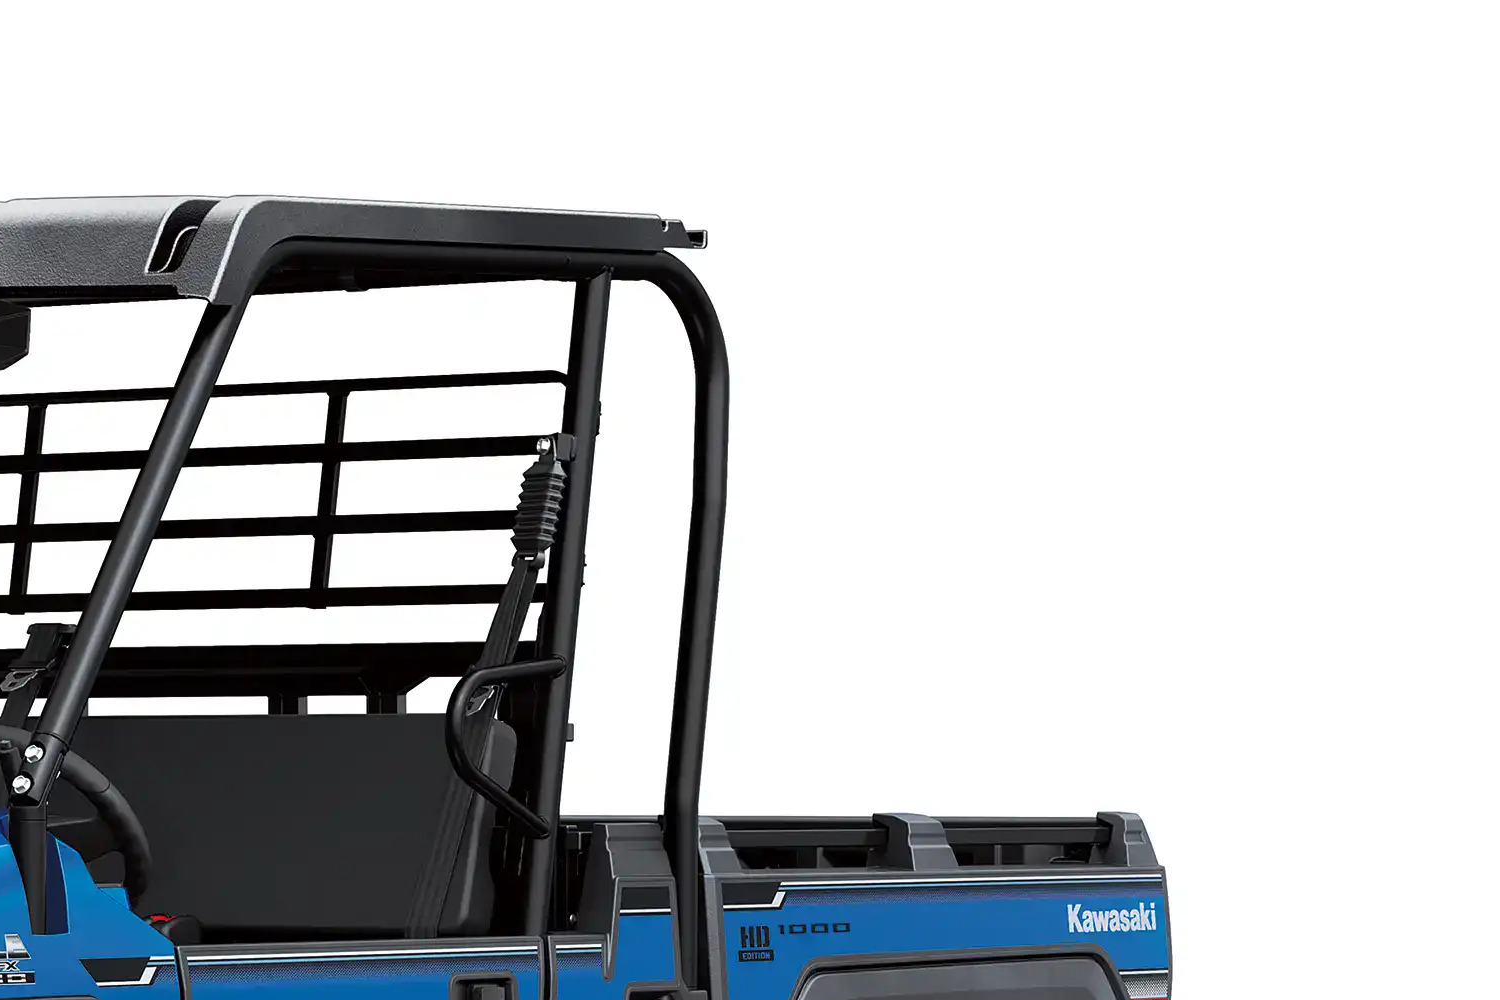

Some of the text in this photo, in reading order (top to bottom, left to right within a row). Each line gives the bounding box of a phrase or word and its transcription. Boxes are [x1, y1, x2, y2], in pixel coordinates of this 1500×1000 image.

[1067, 902, 1157, 933] Kawasaki
[740, 925, 770, 949] HD
[778, 922, 851, 935] 1000
[742, 951, 771, 960] EDITION
